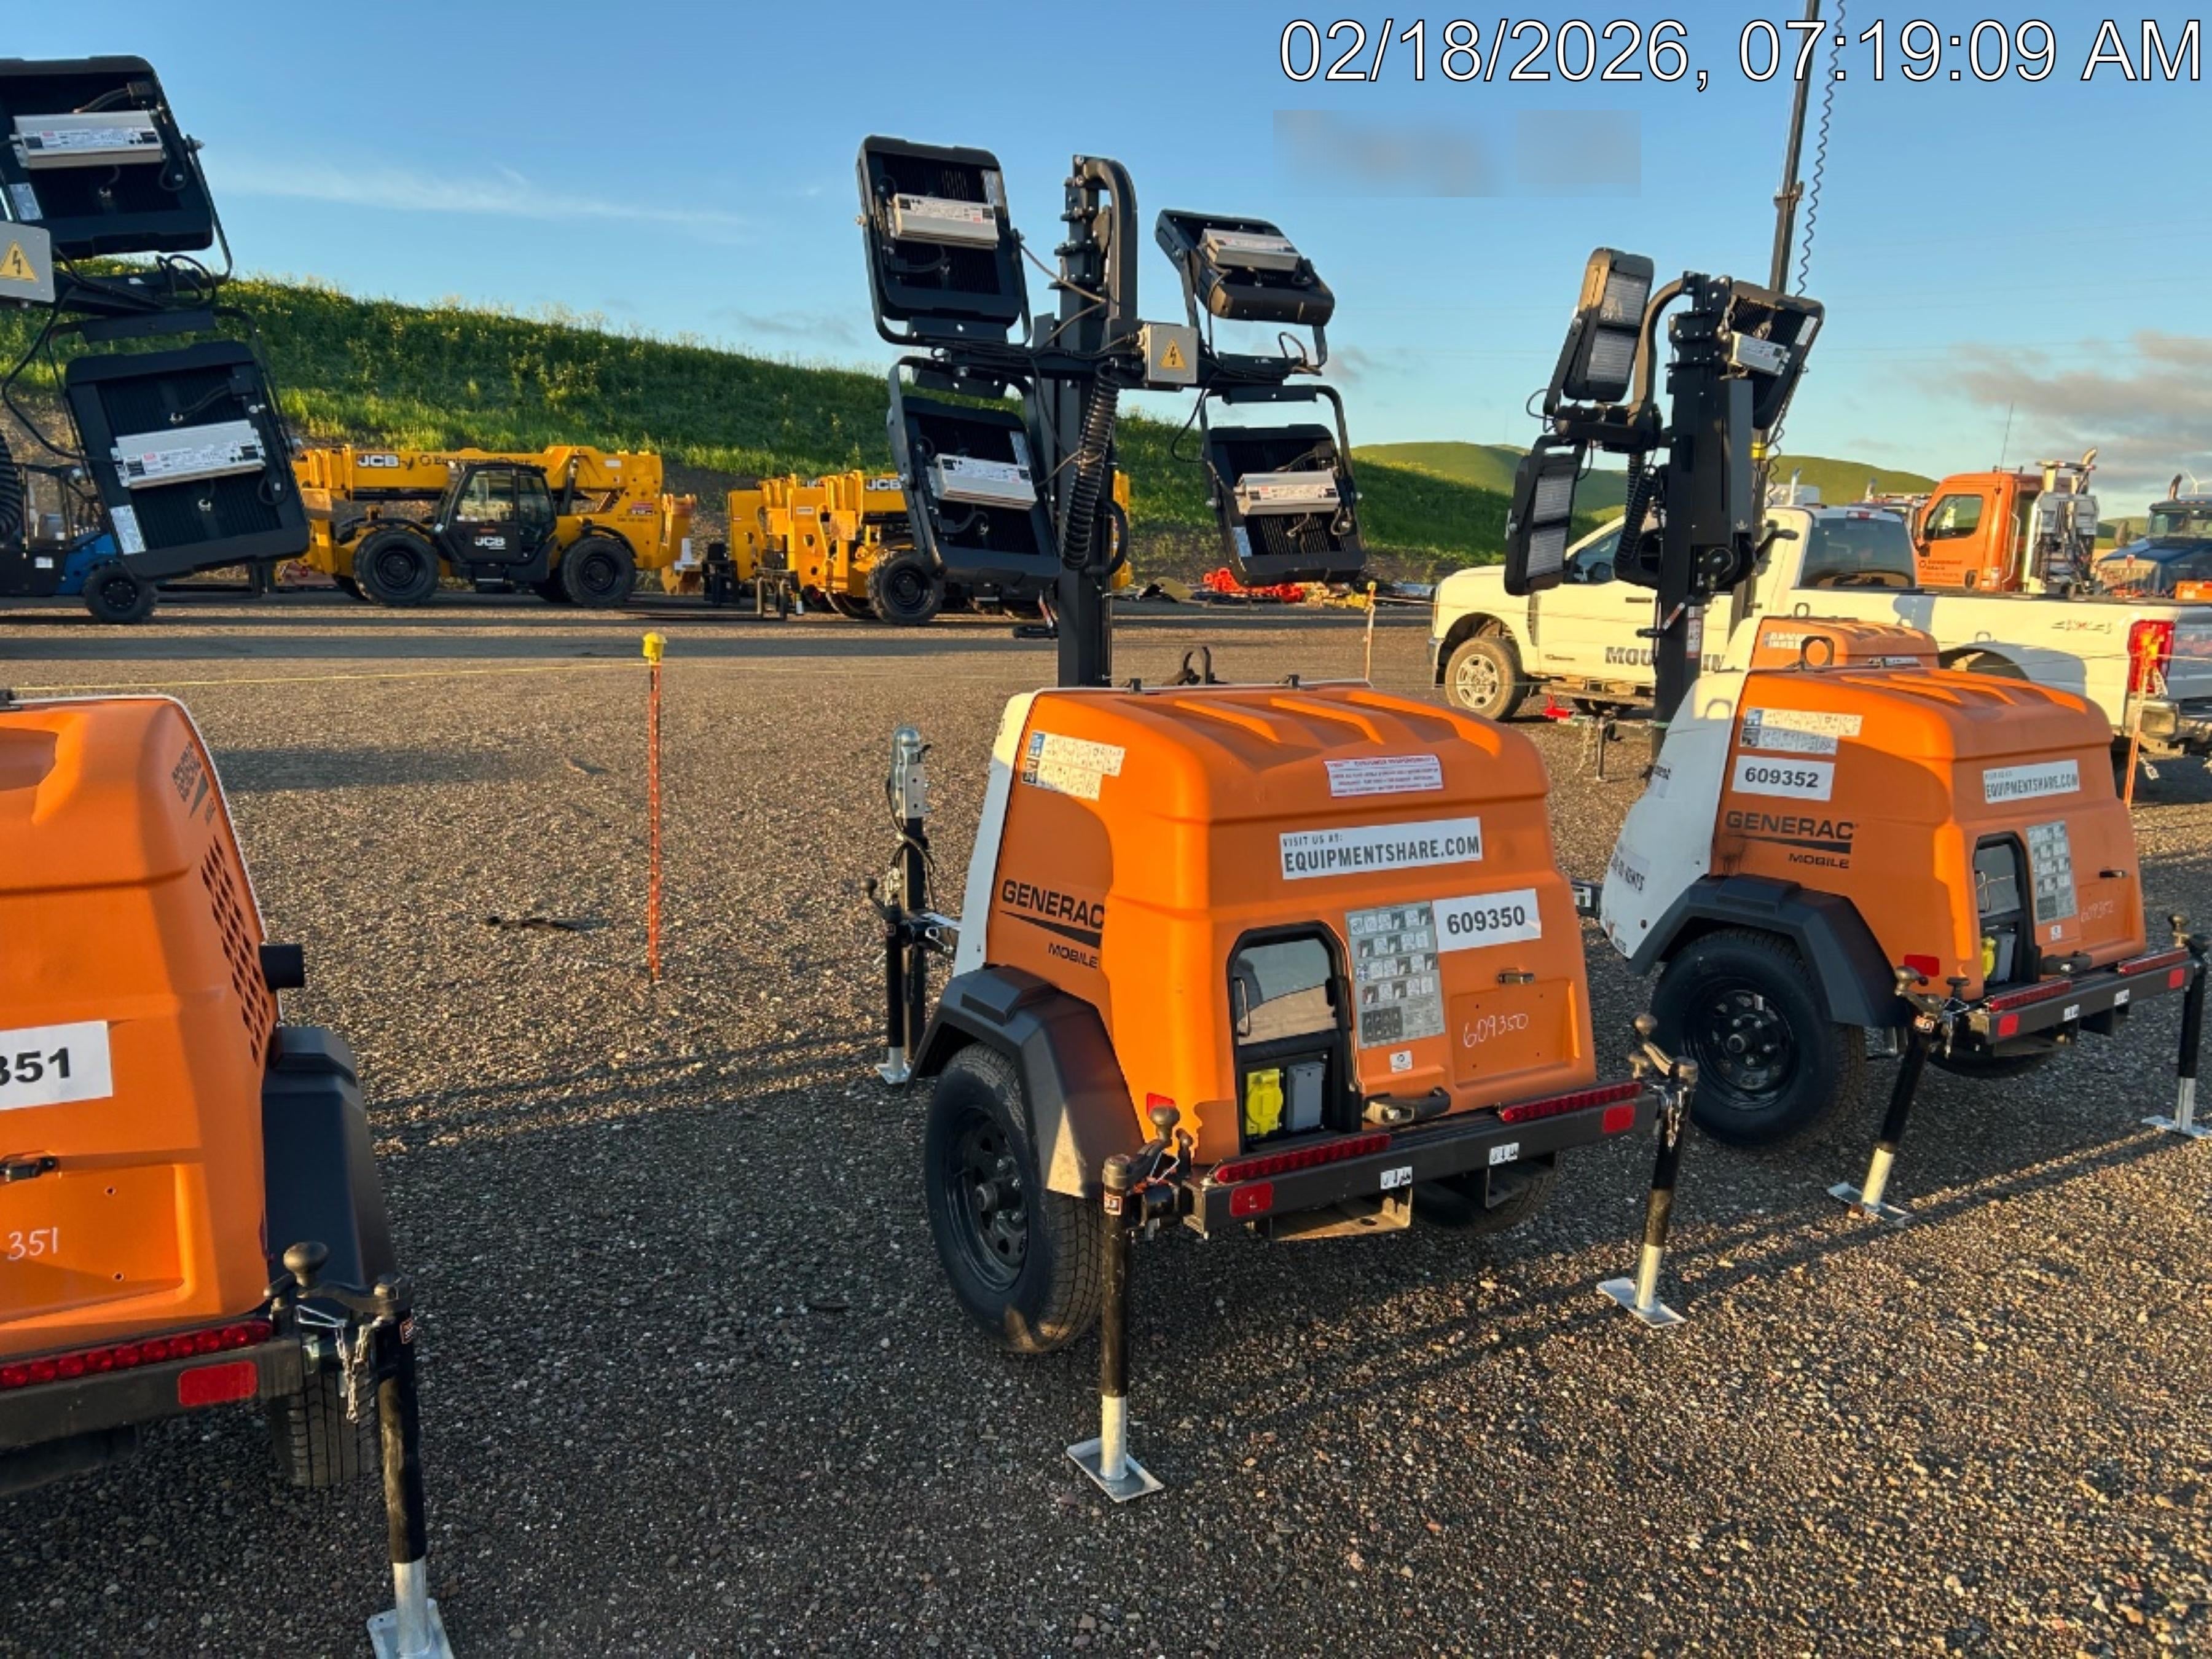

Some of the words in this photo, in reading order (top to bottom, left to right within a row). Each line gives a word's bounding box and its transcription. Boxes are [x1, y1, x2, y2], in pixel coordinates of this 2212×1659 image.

[358, 454, 399, 467] JCB
[866, 479, 902, 490] JCB
[474, 536, 506, 546] JCB
[1745, 767, 1819, 788] 609352
[1725, 810, 1853, 840] GENERAC
[1283, 836, 1308, 847] VISIT
[1312, 835, 1324, 844] US
[1329, 833, 1342, 842] AT:
[1284, 836, 1479, 872] EQUIPMENTSHARE.COM
[1789, 853, 1849, 869] MOBILE
[1002, 879, 1105, 929] GENERAC
[1447, 906, 1525, 935] 609350
[1048, 943, 1097, 969] MOBILE
[1464, 1014, 1528, 1047] 609350
[7, 1227, 58, 1260] 351
